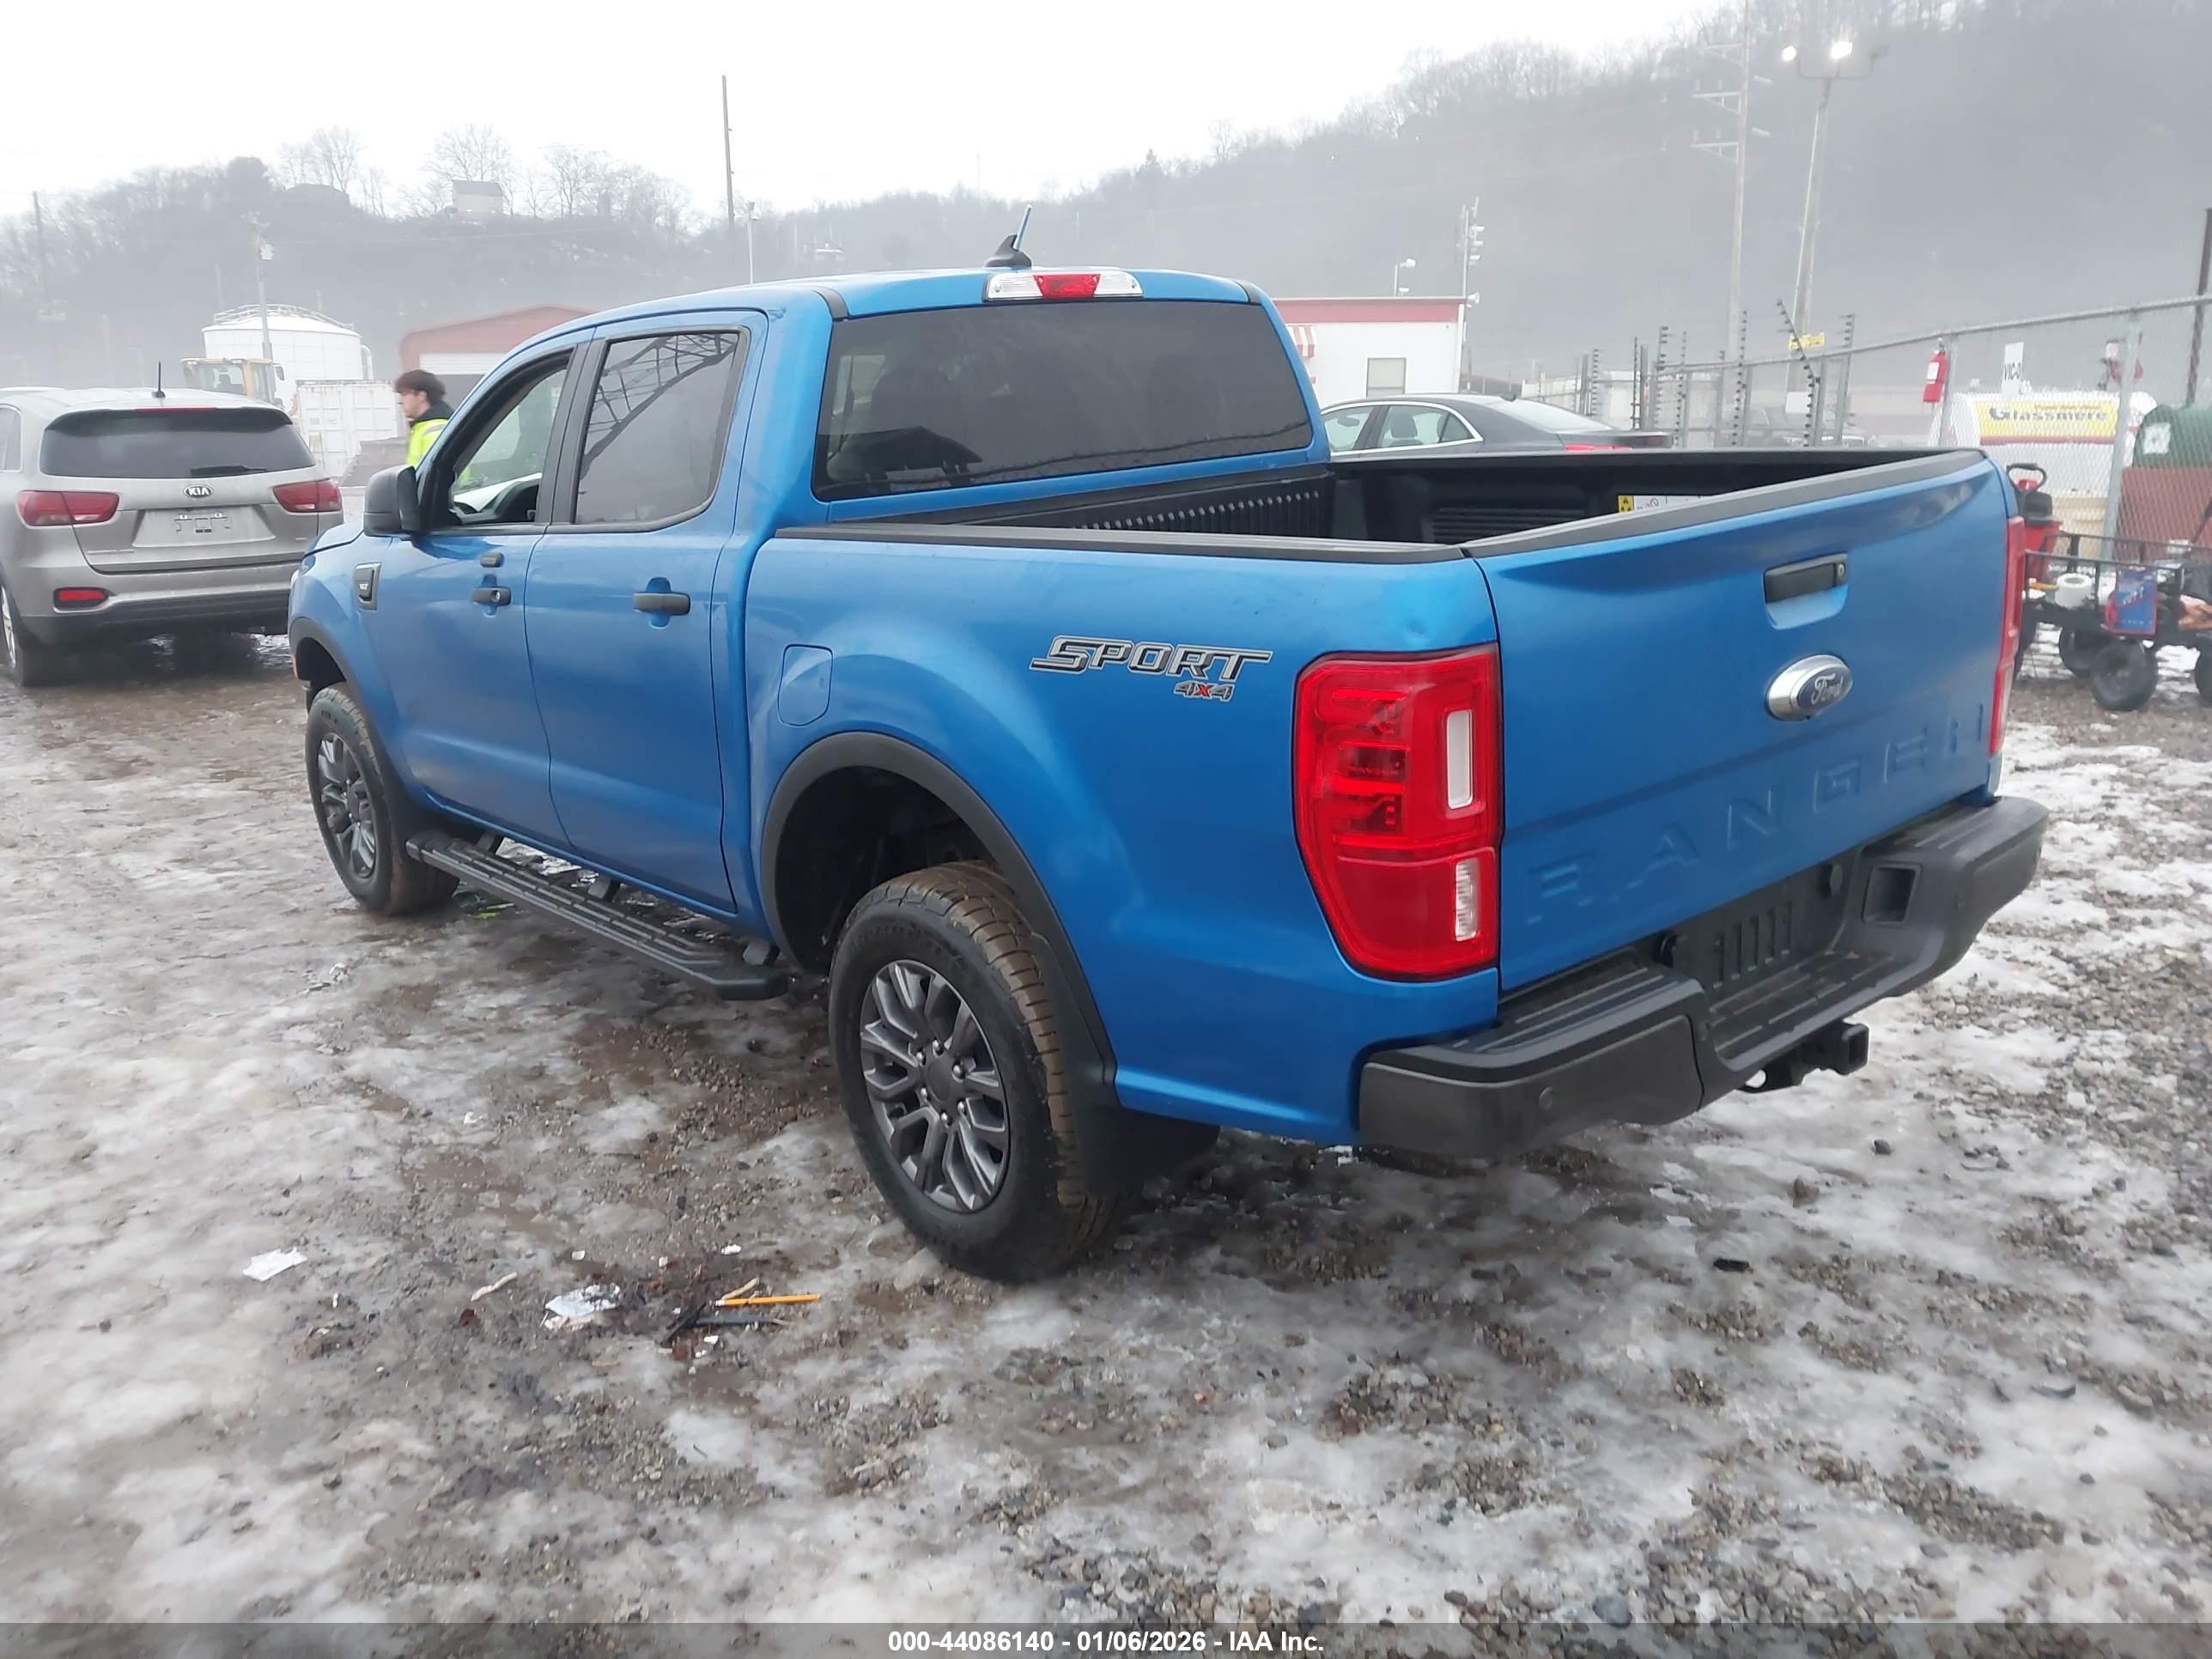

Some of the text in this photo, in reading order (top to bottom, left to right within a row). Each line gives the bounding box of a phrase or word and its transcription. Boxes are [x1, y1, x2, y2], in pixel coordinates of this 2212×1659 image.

[188, 487, 210, 495] KIA
[1030, 635, 1273, 683] SPORT
[1811, 672, 1844, 705] Ford
